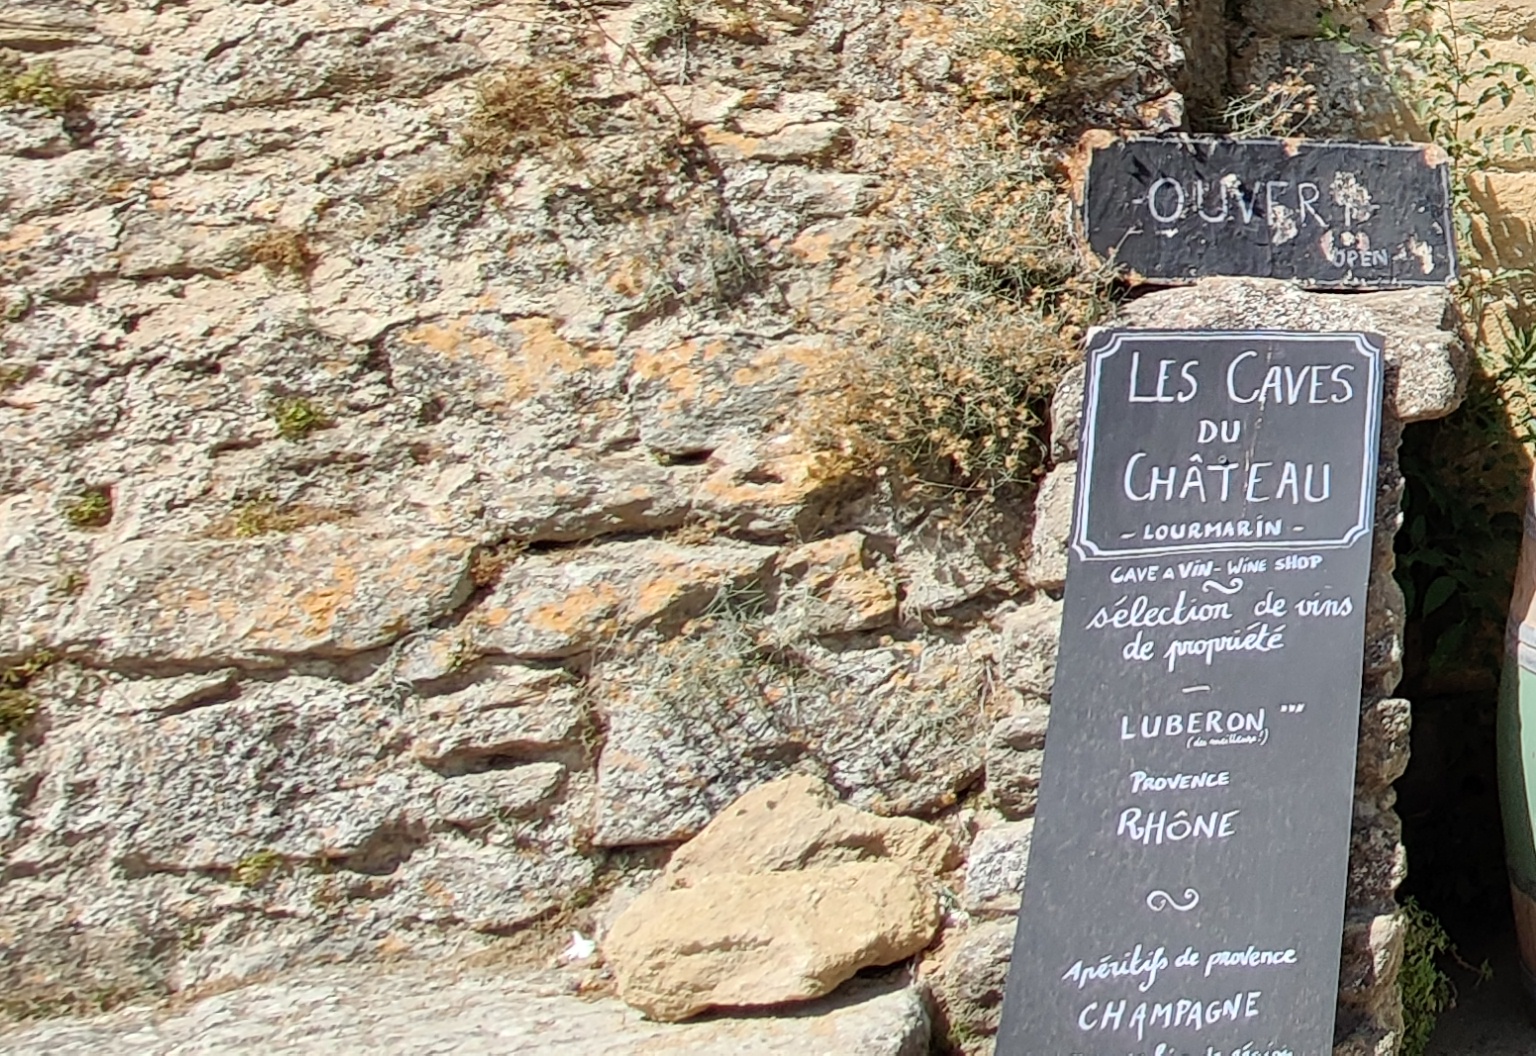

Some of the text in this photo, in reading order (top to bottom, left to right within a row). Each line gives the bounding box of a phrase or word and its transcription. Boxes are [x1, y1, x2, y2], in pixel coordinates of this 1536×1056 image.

[1333, 247, 1389, 269] OPEN
[1128, 350, 1355, 405] LES CAVES
[1197, 419, 1241, 444] DU
[1122, 451, 1331, 504] CHÂTEAU
[1110, 565, 1159, 584] CAVE
[1274, 554, 1324, 572] SHOP
[1085, 590, 1354, 630] sélection de vins
[1122, 621, 1288, 673] de propriété
[1120, 707, 1266, 741] LUBERON
[1129, 771, 1231, 794] PROVENCE
[1117, 807, 1241, 845] RHÔNE
[1061, 944, 1170, 993] Apéritifs
[1174, 947, 1201, 968] de
[1077, 991, 1263, 1041] CHAMPAGNE
